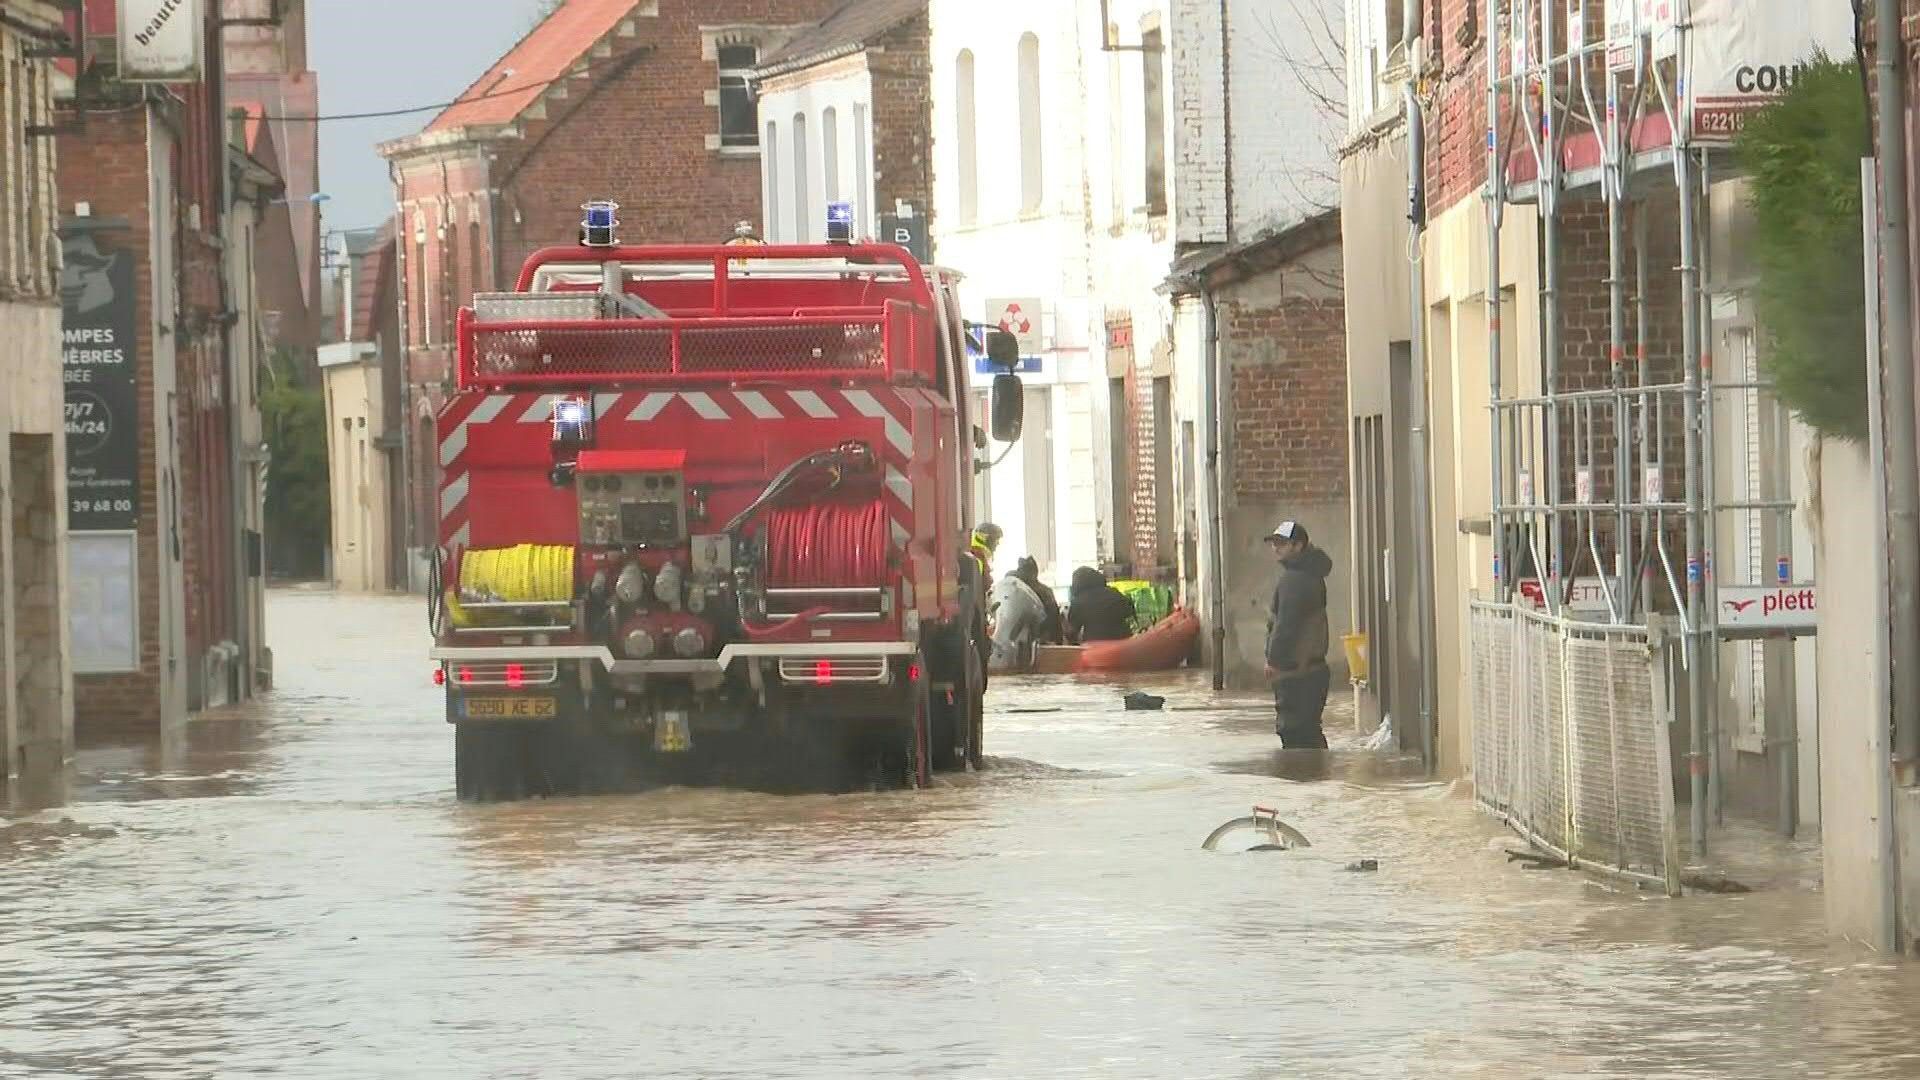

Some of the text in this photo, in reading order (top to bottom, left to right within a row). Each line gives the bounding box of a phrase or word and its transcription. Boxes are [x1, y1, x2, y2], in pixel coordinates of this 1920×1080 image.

[1736, 65, 1808, 93] COU
[895, 228, 911, 243] B
[63, 328, 114, 343] MPES
[73, 500, 132, 512] 39 68 00
[1763, 589, 1817, 616] plett
